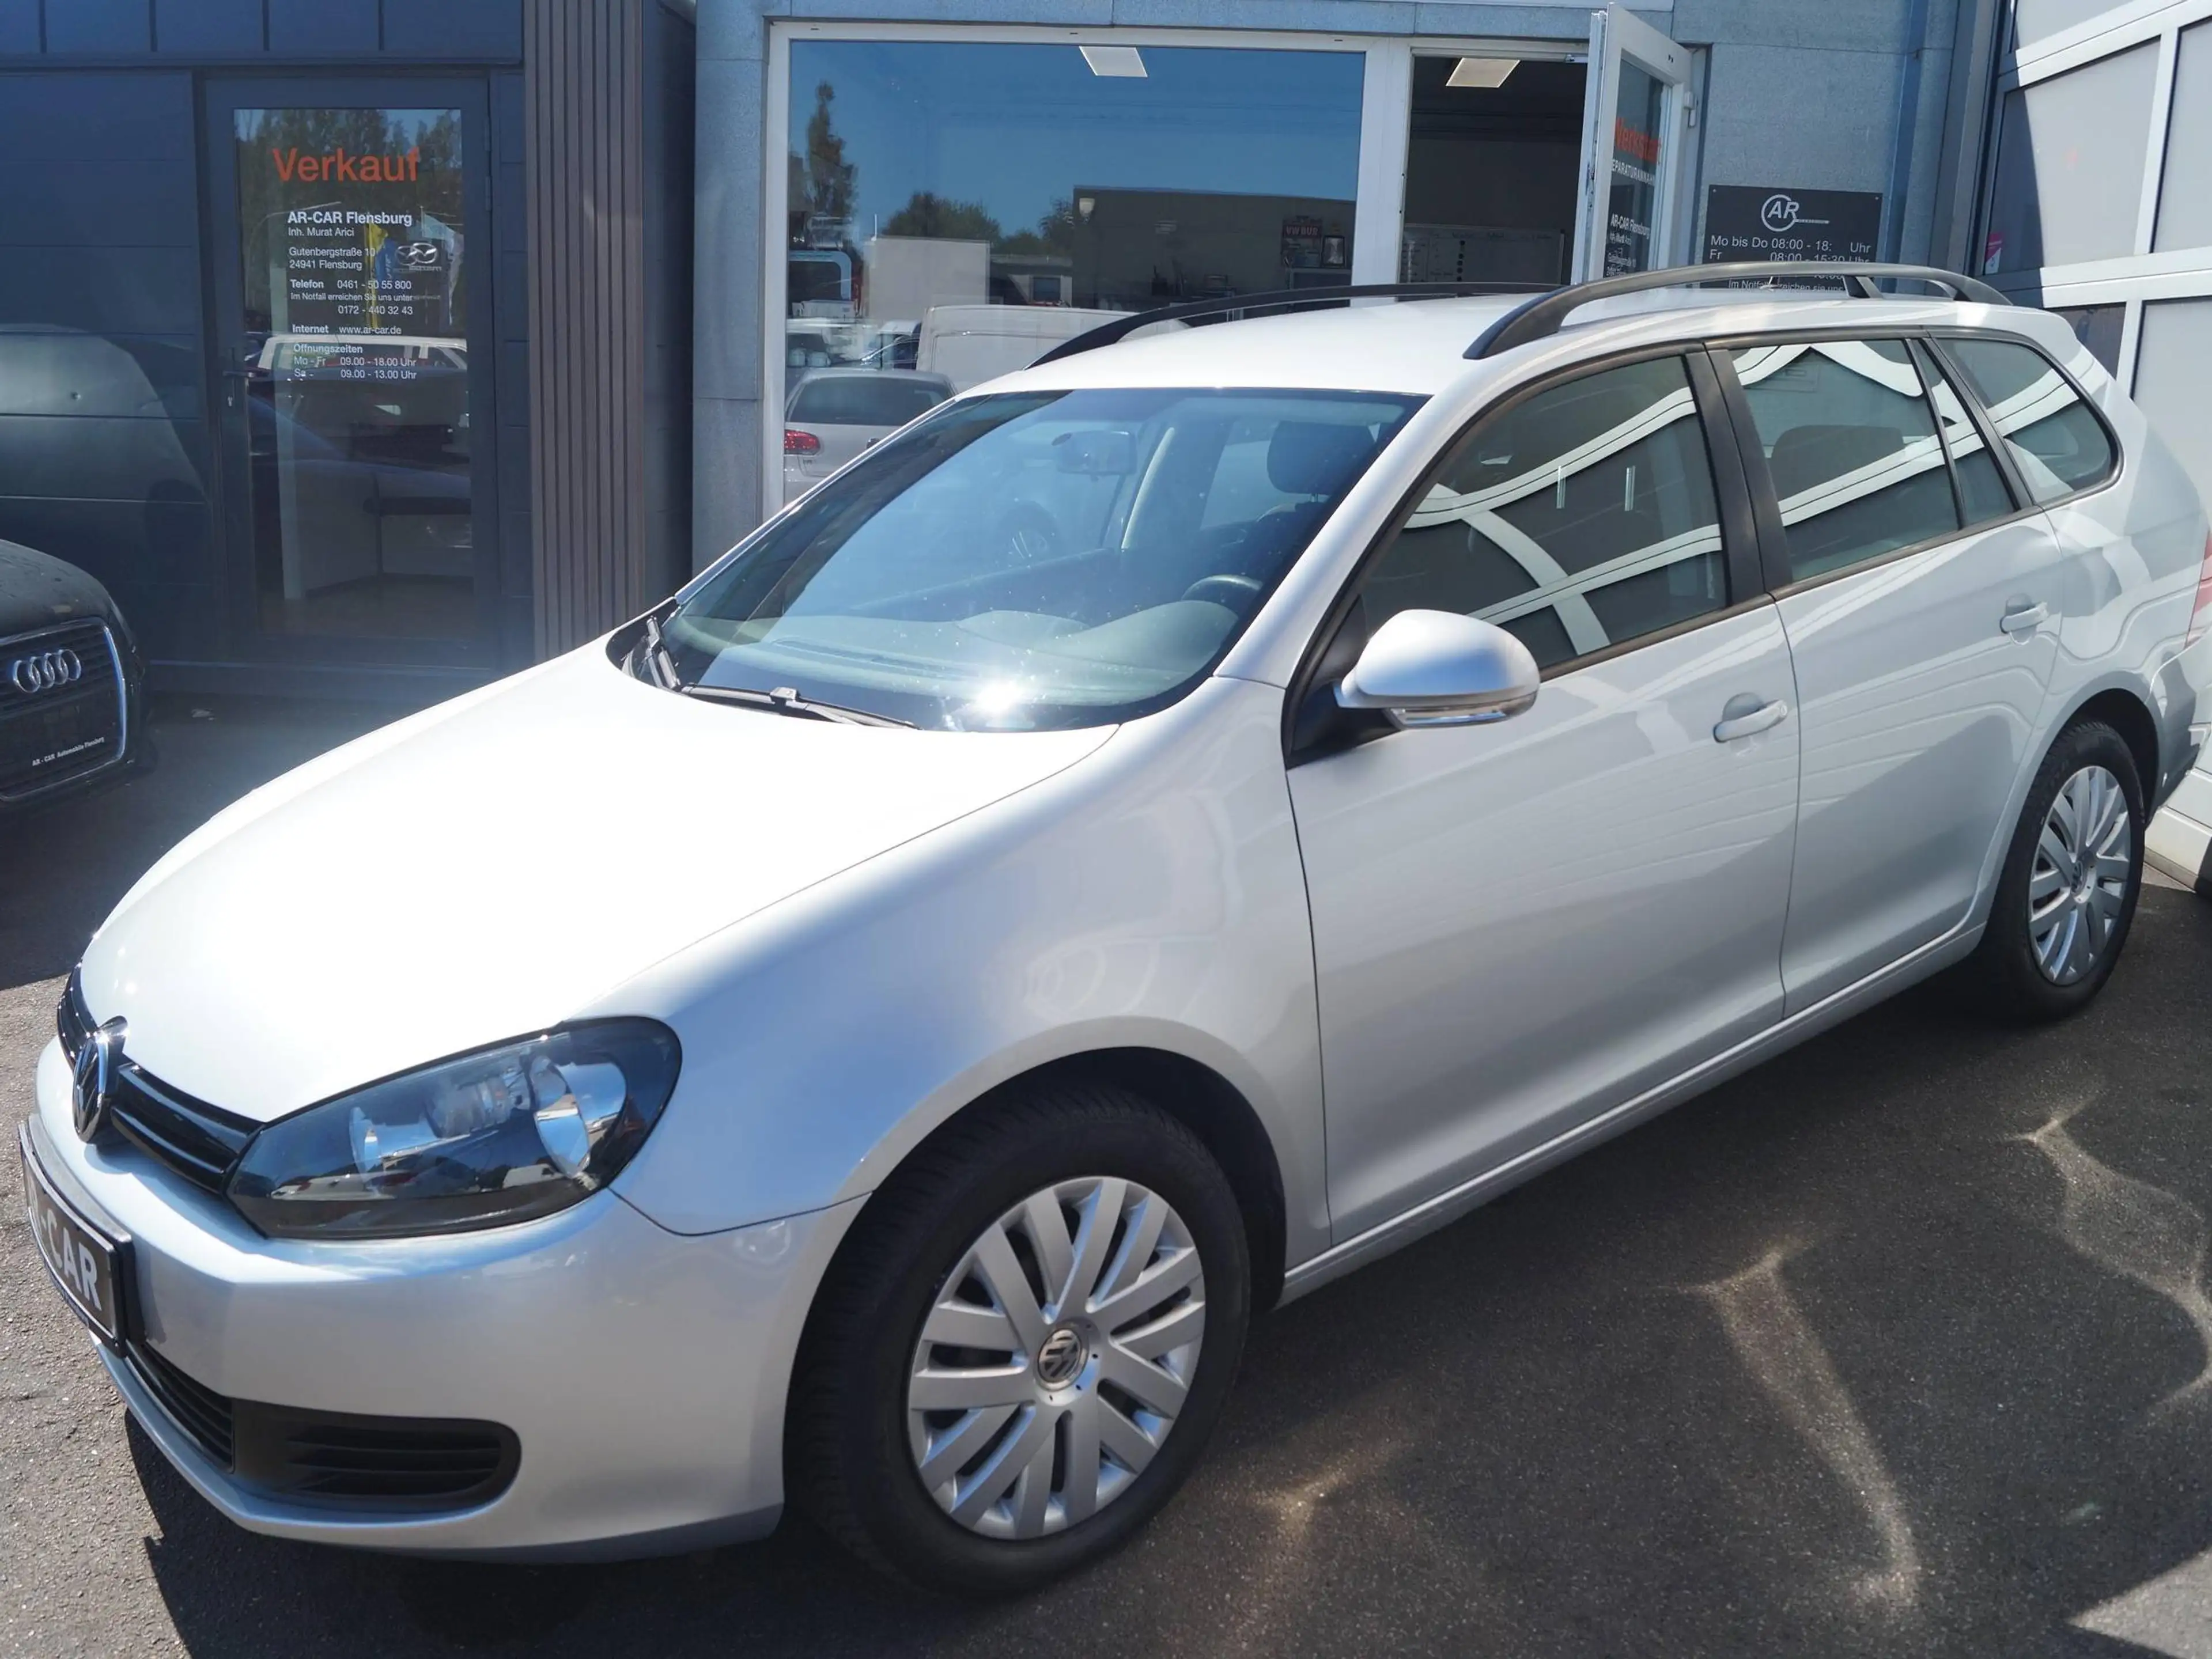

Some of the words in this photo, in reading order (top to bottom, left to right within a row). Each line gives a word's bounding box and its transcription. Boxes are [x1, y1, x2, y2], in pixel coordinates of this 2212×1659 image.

[273, 147, 420, 182] Verkauf
[288, 211, 343, 224] AR-CAR
[346, 211, 413, 227] Flensburg
[288, 227, 304, 237] Inh.
[307, 227, 334, 237] Murat
[335, 227, 354, 237] Arici
[1711, 235, 1729, 247] Mo
[1731, 236, 1748, 247] bis
[1752, 237, 1768, 248] Do
[1771, 238, 1803, 249] 08:00
[1850, 241, 1871, 253] Uhr
[289, 247, 362, 259] Gutenbergstraße
[1710, 249, 1722, 260] Fr
[289, 260, 316, 269] 24941
[319, 260, 362, 271] Flensburg
[290, 279, 324, 289] Telefon
[337, 280, 358, 289] 0461
[381, 280, 392, 289] 55
[395, 281, 411, 290] 800
[290, 292, 300, 300] Im
[302, 292, 326, 301] Notfall
[328, 293, 362, 301] erreichen
[394, 294, 413, 302] unter
[338, 305, 360, 315] 0172
[368, 306, 385, 315] 440
[388, 306, 399, 315] 32
[401, 306, 413, 315] 43
[292, 324, 329, 334] Internet
[339, 325, 402, 335] www.ar-car.de
[294, 357, 308, 365] Mo
[340, 357, 365, 366] 09.00
[374, 357, 398, 366] 18.00
[400, 358, 417, 367] Uhr
[294, 368, 306, 377] Sa
[341, 370, 365, 379] 09.00
[375, 370, 399, 379] 13.00
[400, 370, 417, 379] Uhr
